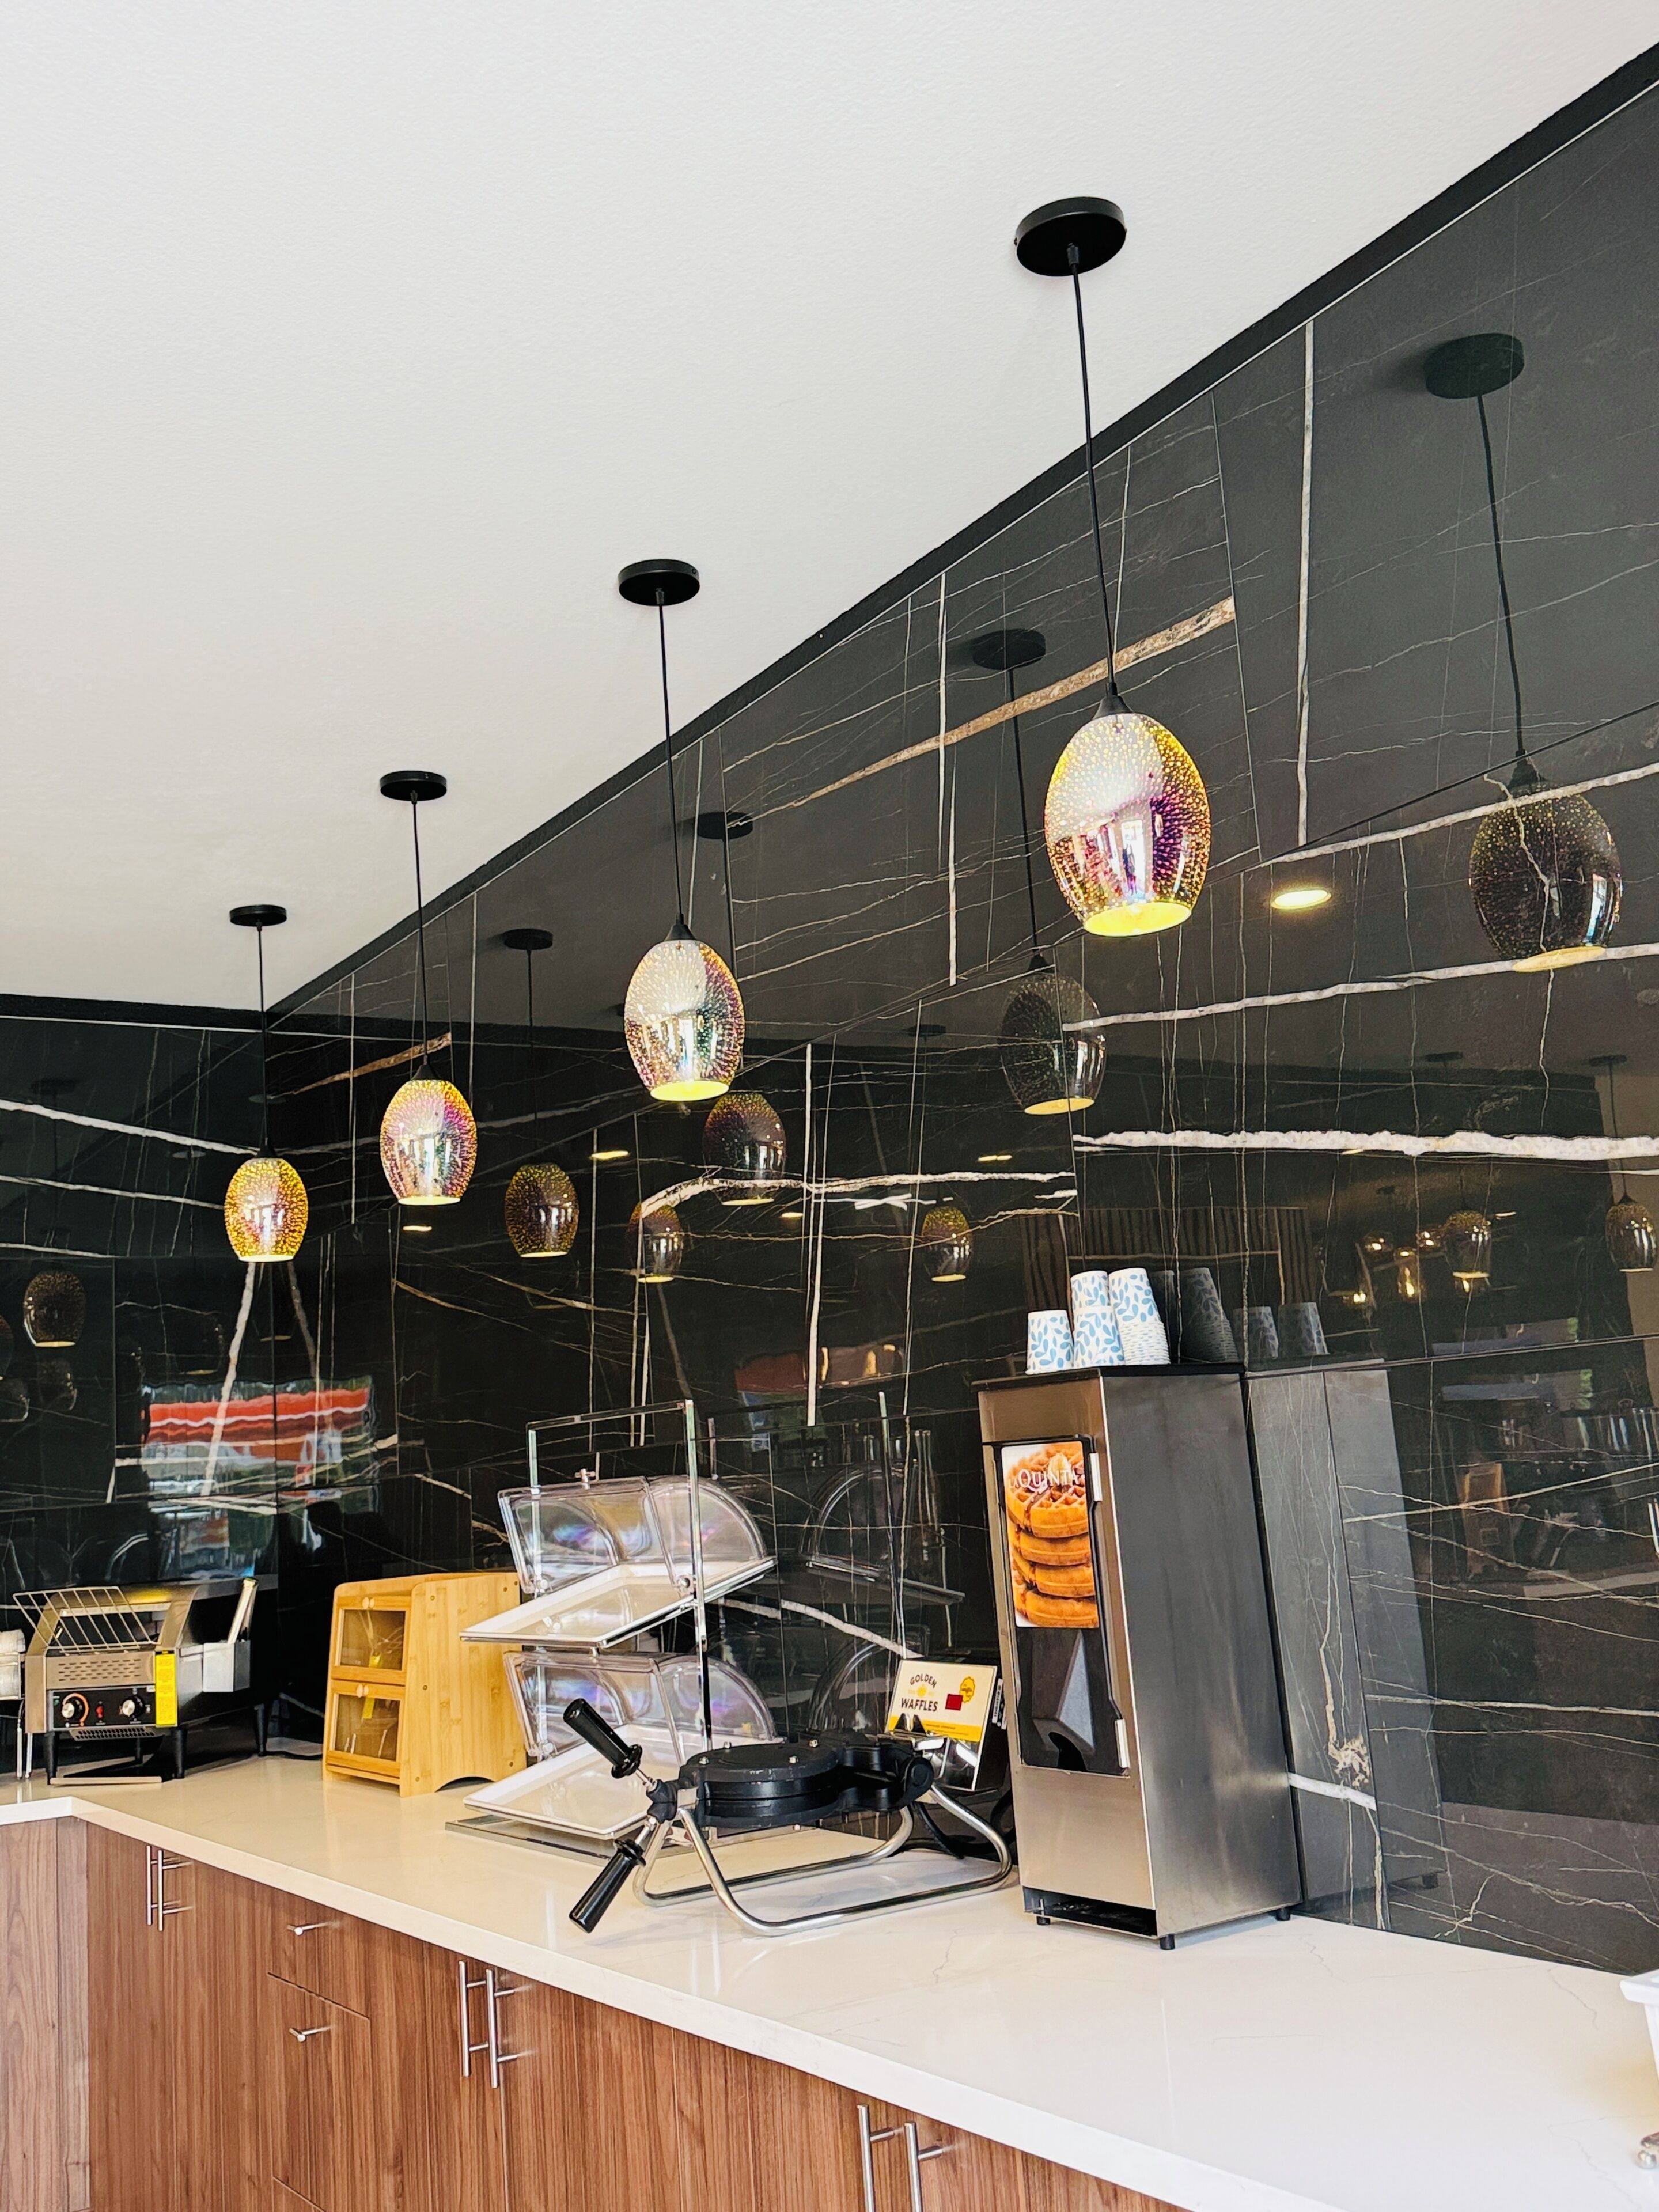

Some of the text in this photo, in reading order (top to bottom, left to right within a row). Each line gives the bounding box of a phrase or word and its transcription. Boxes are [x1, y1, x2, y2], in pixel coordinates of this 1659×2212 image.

[1018, 1469, 1080, 1493] QUINTA
[910, 1673, 937, 1688] GOLDEN
[901, 1698, 938, 1712] WAFFLES
